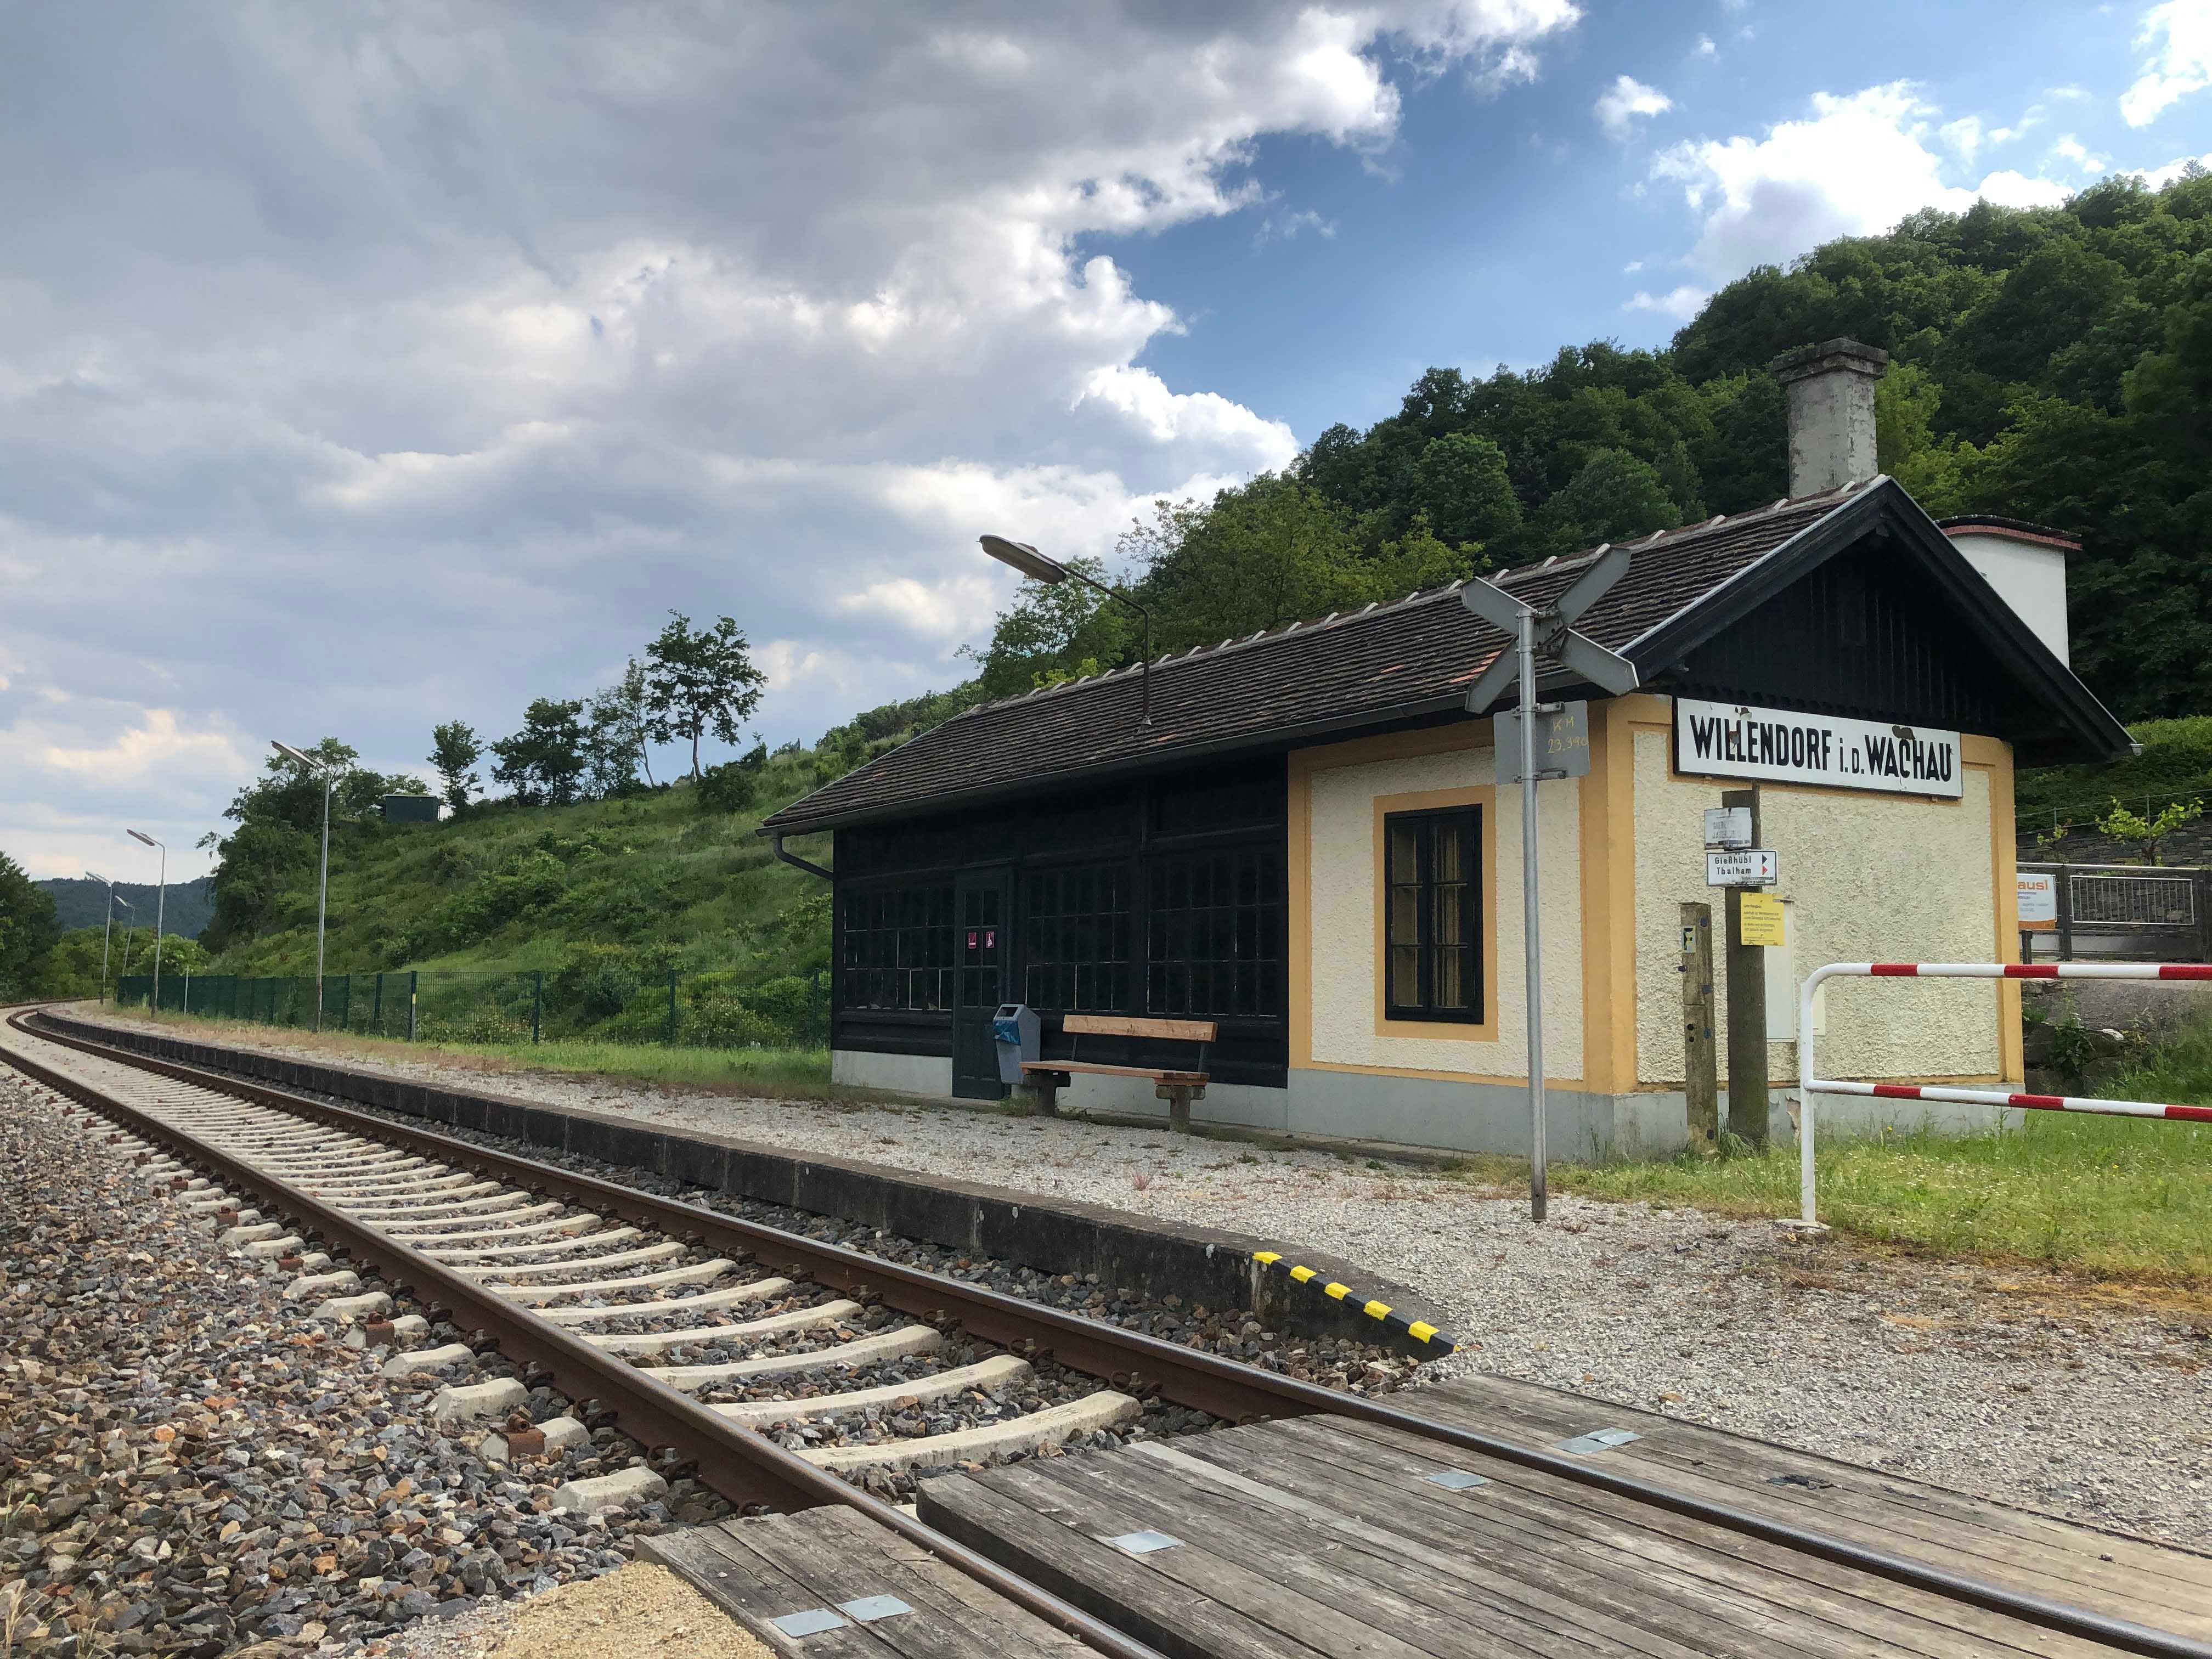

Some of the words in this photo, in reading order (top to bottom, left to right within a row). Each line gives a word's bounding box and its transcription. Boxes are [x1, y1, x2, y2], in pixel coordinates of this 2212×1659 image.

[1689, 714, 1832, 771] WILLENDORF
[1864, 735, 1952, 782] WACHAU
[1715, 855, 1751, 865] Gießhübl
[1717, 867, 1751, 875] Thalham
